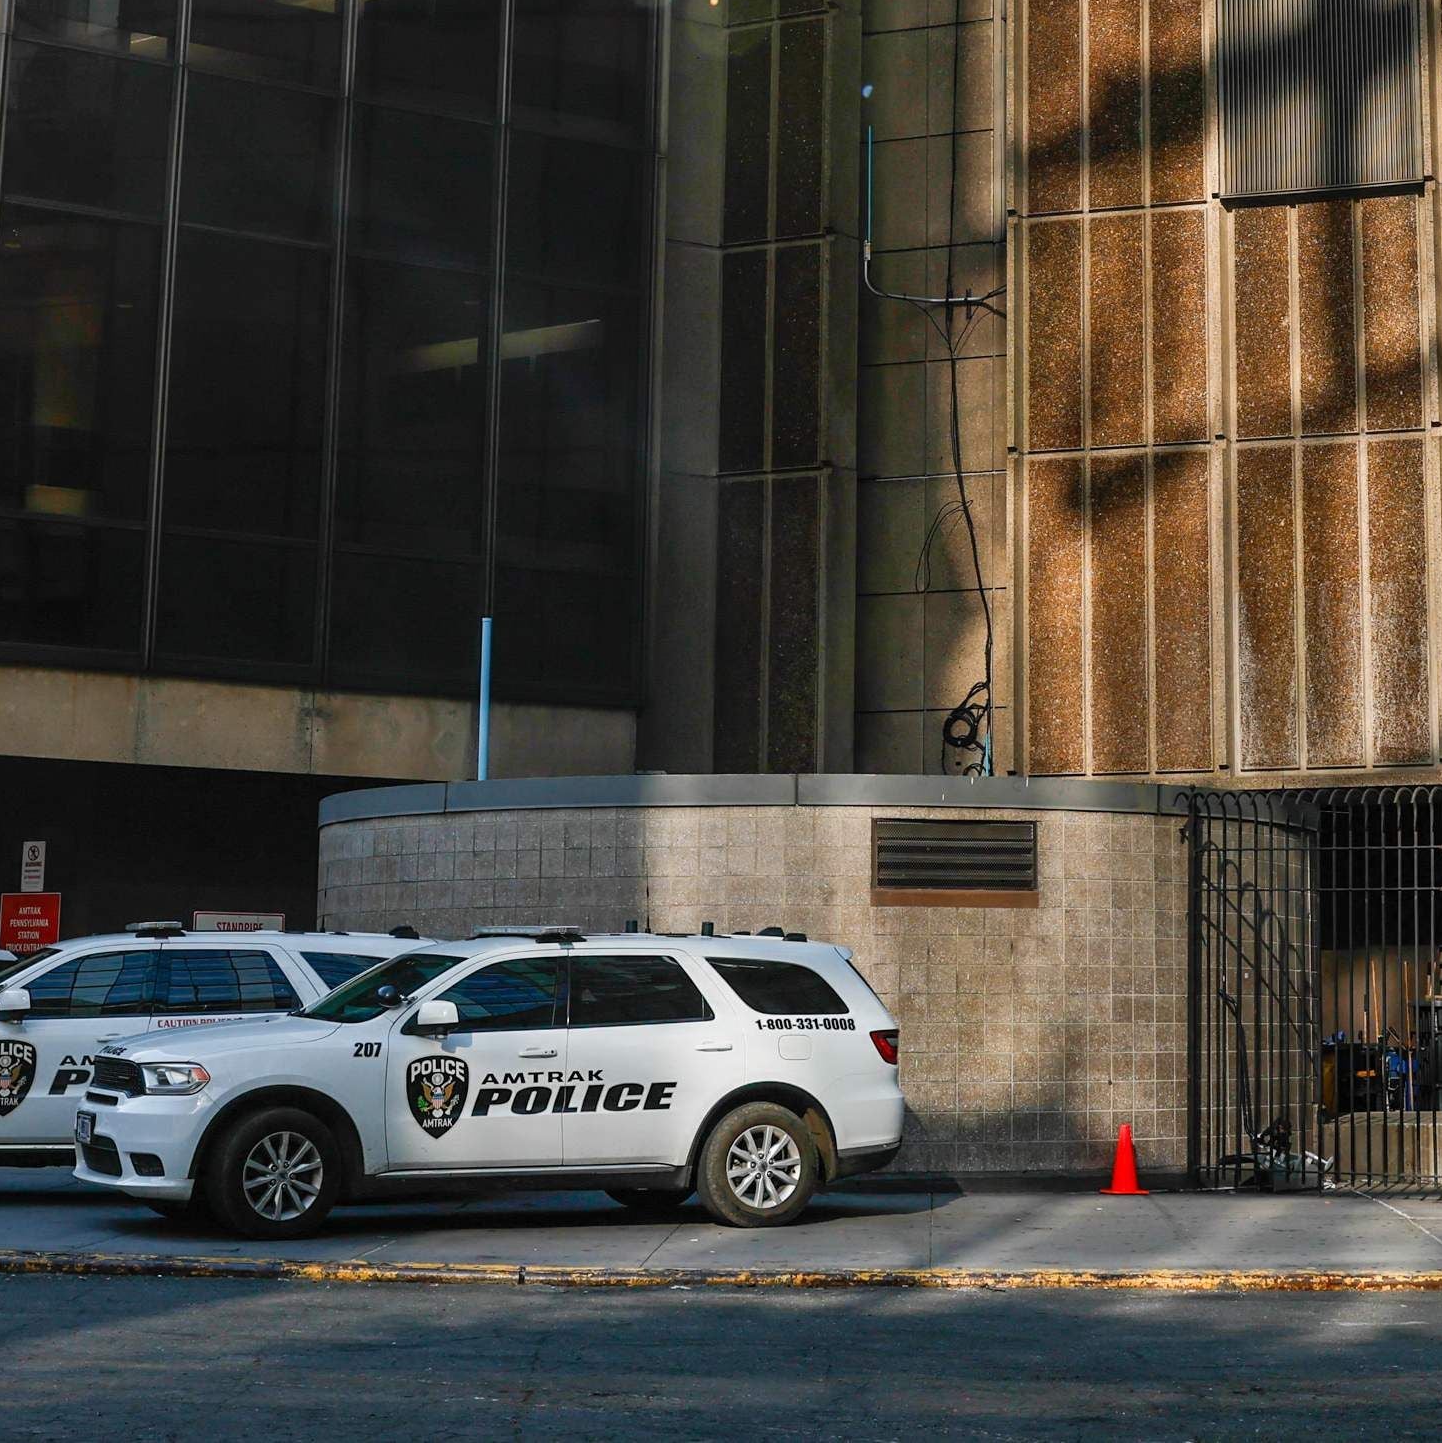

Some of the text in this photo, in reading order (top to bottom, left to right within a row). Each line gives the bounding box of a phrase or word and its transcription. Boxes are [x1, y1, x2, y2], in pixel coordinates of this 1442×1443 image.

[755, 1018, 856, 1031] 1-800-331-0008
[353, 1042, 382, 1058] 207
[410, 1059, 466, 1083] POLICE
[482, 1069, 604, 1086] AMTRAK
[471, 1082, 677, 1117] POLICE
[422, 1117, 453, 1129] AMTRAK
